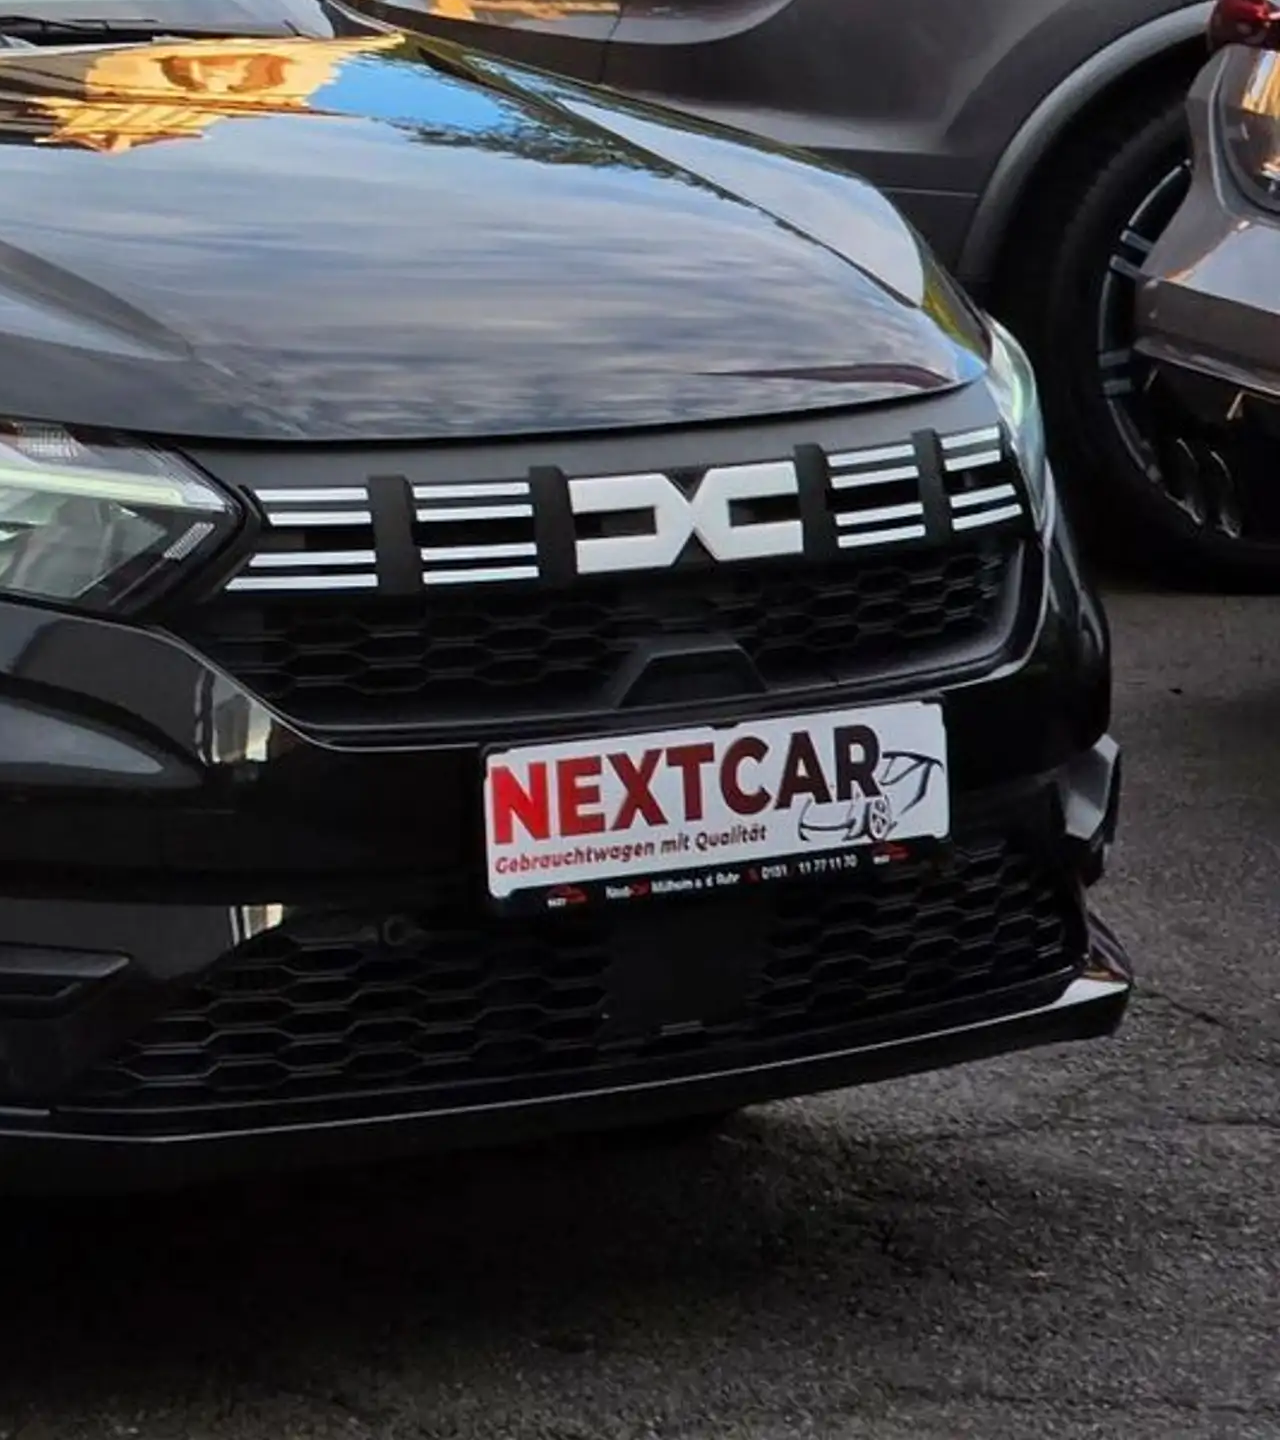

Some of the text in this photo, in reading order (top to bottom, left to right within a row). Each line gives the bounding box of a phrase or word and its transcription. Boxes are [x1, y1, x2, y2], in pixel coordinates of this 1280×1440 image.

[491, 724, 882, 845] NEXTCAR
[495, 823, 767, 873] Gebrauchtwagen mit Qualität
